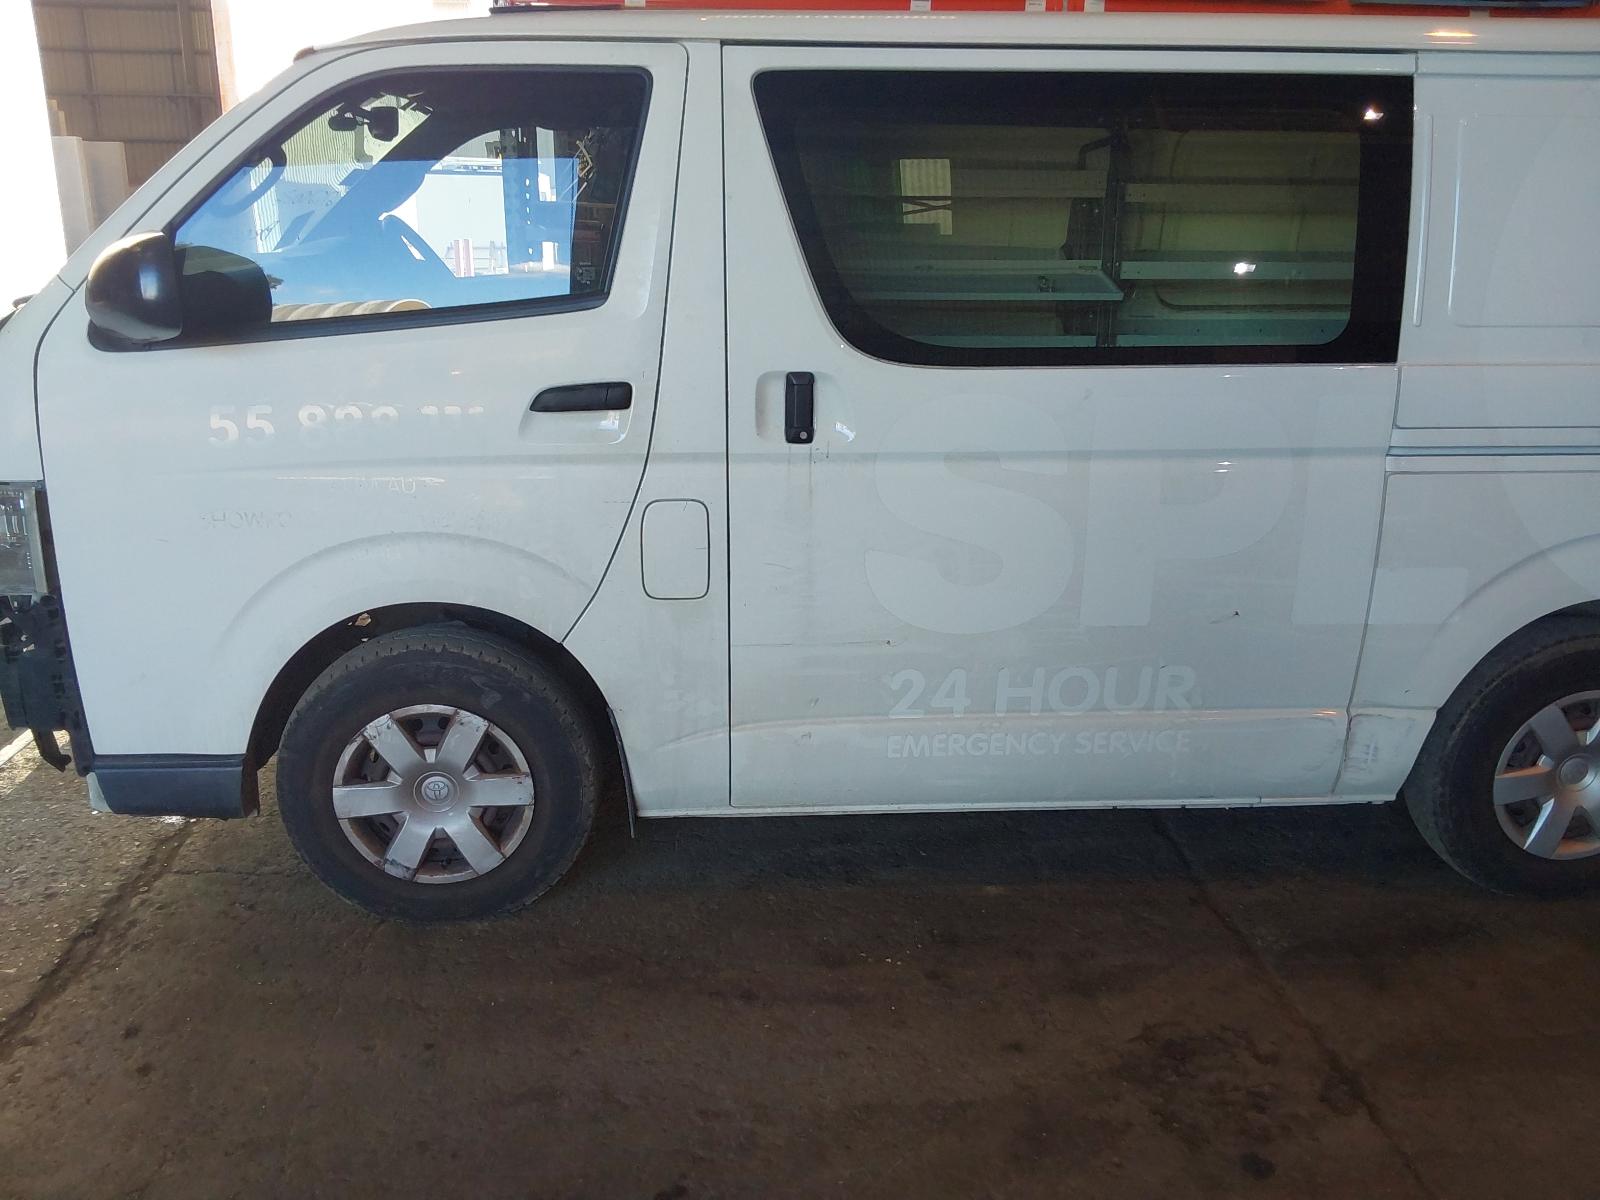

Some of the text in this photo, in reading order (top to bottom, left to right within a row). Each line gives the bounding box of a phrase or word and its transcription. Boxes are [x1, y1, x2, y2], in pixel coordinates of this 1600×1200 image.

[207, 404, 276, 447] 55
[888, 665, 1196, 719] 24 HOUR
[886, 729, 1193, 759] EMERGENCY SERVICE
